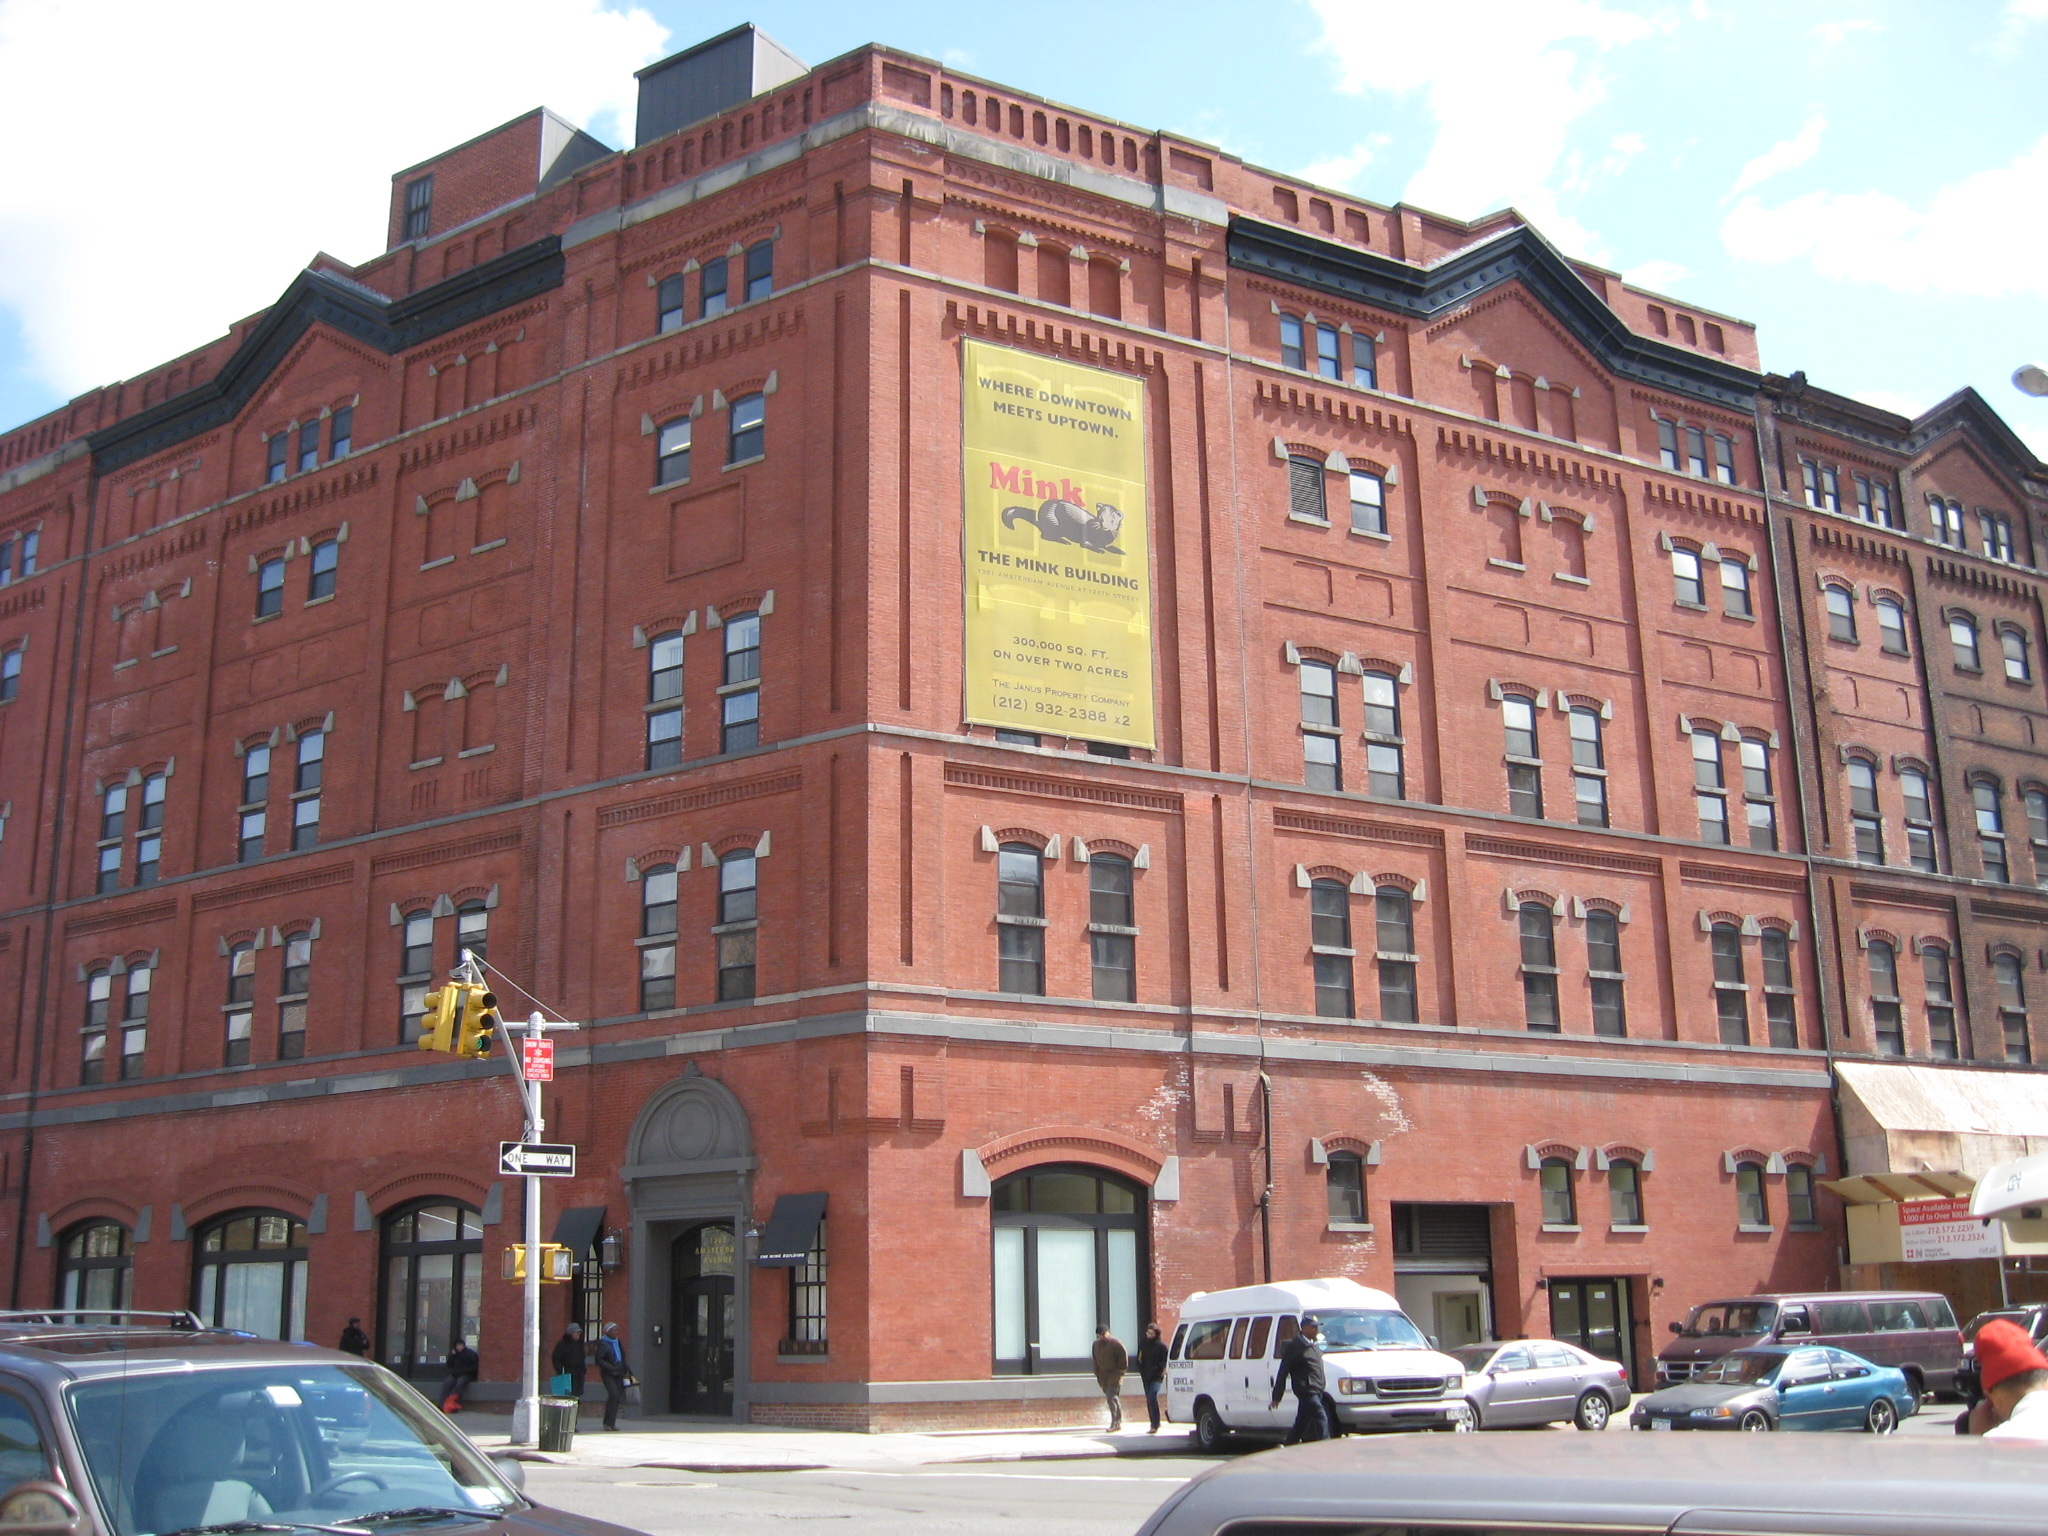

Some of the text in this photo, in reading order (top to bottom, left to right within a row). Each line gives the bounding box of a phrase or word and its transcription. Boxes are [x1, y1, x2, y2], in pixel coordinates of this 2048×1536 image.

[979, 377, 1132, 421] WHERE DOWNTOWN
[993, 401, 1118, 438] MEETS UPTOWN.
[989, 462, 1086, 507] Mink
[978, 550, 1139, 590] THE MINK BUILDING
[998, 572, 1043, 584] AMSTERDAM
[1047, 581, 1075, 591] AVENUE
[1113, 593, 1139, 601] STREET
[1013, 636, 1109, 660] 300,000 SQ. FT.
[993, 650, 1129, 679] ON OVER TWO ACRES
[992, 694, 1028, 712] (212)
[1035, 702, 1107, 722] 932-2388
[508, 1153, 566, 1165] ONE WAY
[1902, 1206, 1920, 1214] Space
[1922, 1203, 1951, 1212] Available
[695, 1246, 735, 1255] AMSTERDA
[704, 1256, 732, 1264] AVENUE
[1979, 1245, 1997, 1254] retail
